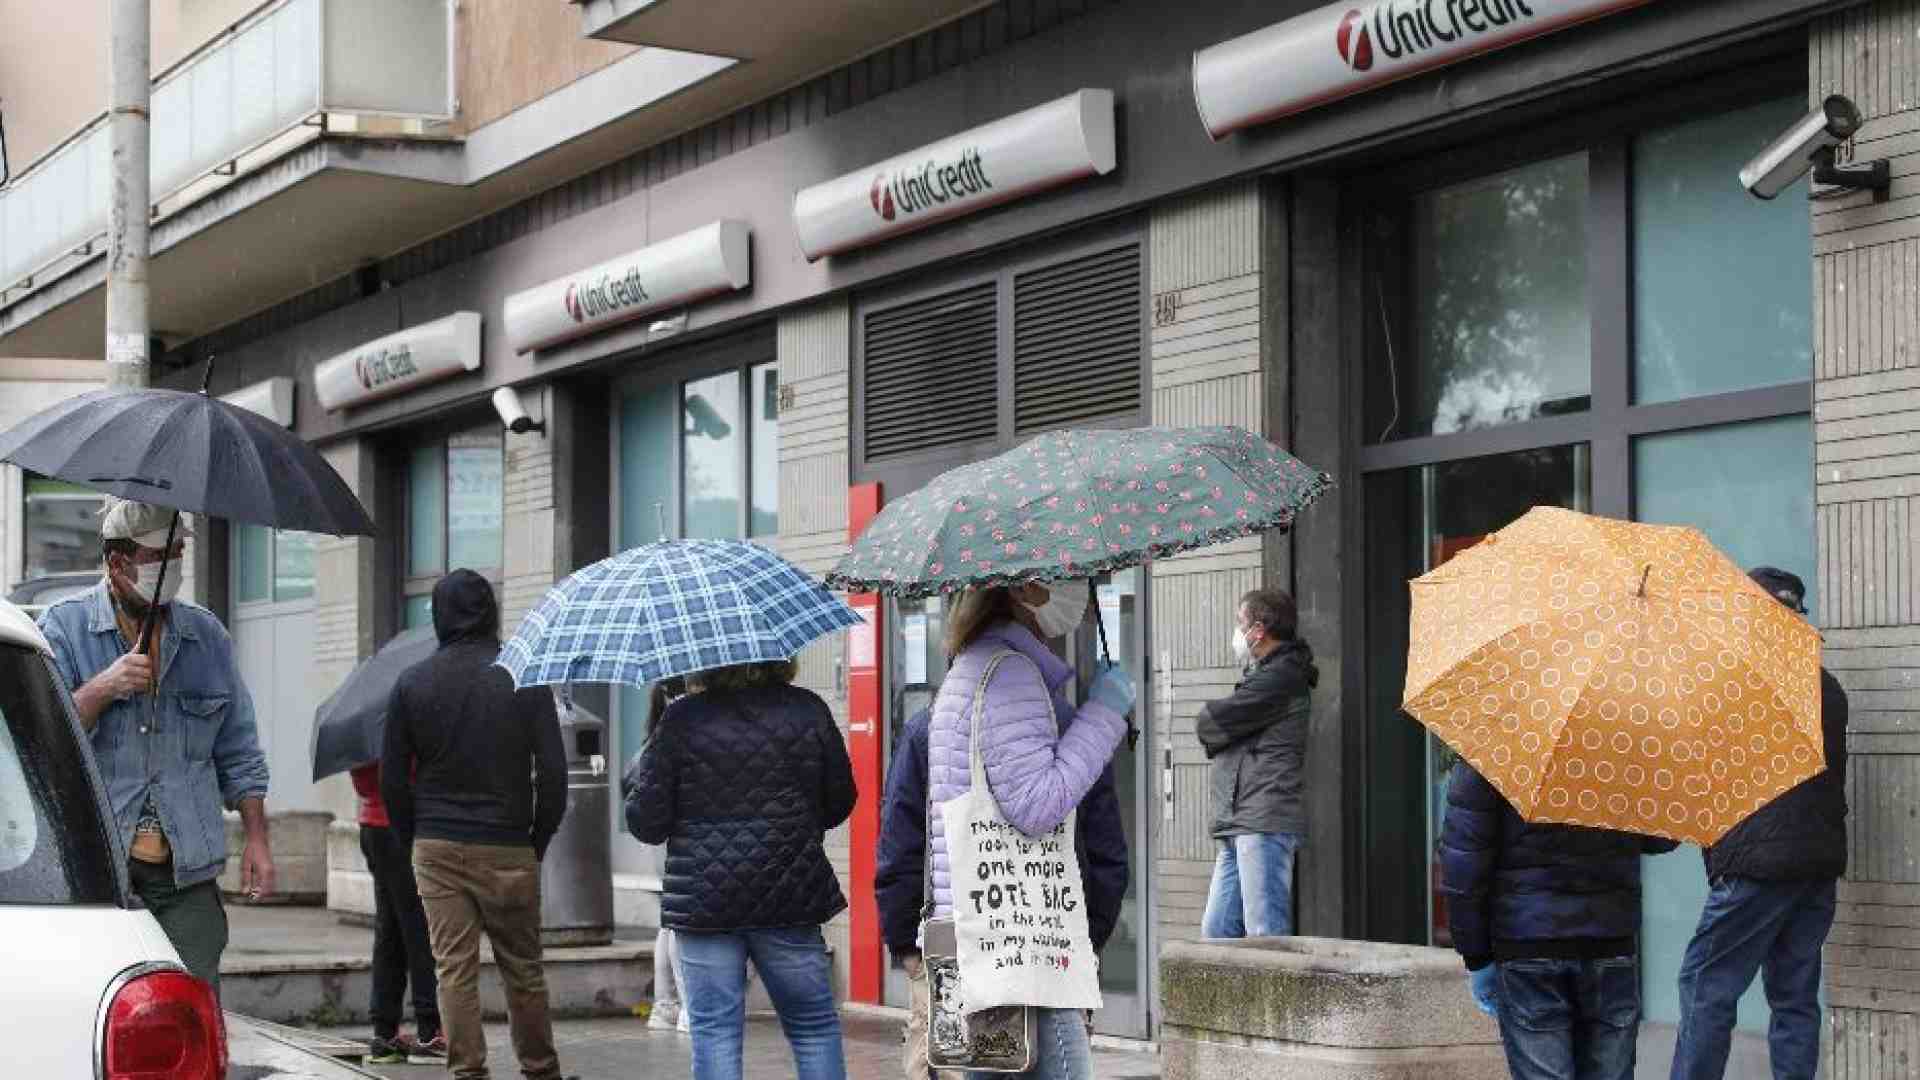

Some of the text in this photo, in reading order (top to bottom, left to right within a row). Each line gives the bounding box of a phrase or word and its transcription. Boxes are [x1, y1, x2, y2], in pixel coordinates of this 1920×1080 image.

[894, 147, 993, 213] UniCredit
[580, 265, 649, 317] UniCredit
[977, 859, 1065, 880] one more
[970, 882, 1077, 914] TOTE BAG
[989, 914, 1005, 930] in
[1012, 910, 1034, 927] the
[979, 937, 995, 952] in
[1003, 935, 1025, 949] my
[995, 952, 1024, 970] and
